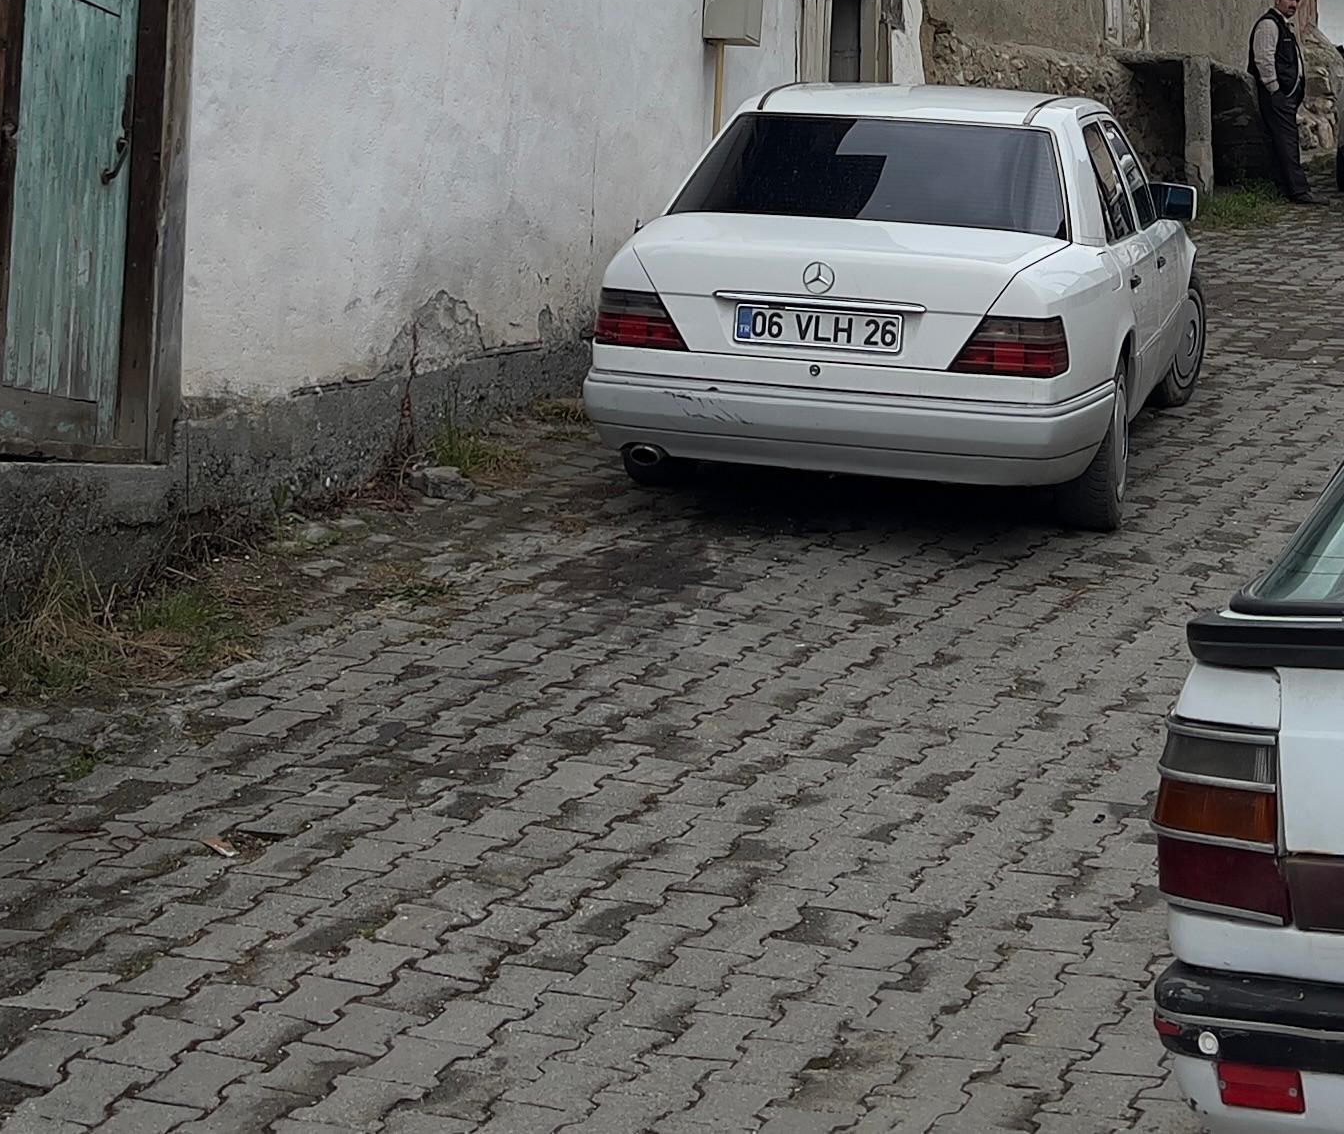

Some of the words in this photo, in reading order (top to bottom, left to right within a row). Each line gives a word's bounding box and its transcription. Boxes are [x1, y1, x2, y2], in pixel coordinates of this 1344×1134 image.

[739, 324, 750, 333] TR
[752, 311, 783, 338] 06
[795, 313, 854, 344] VLH
[863, 319, 897, 347] 26
